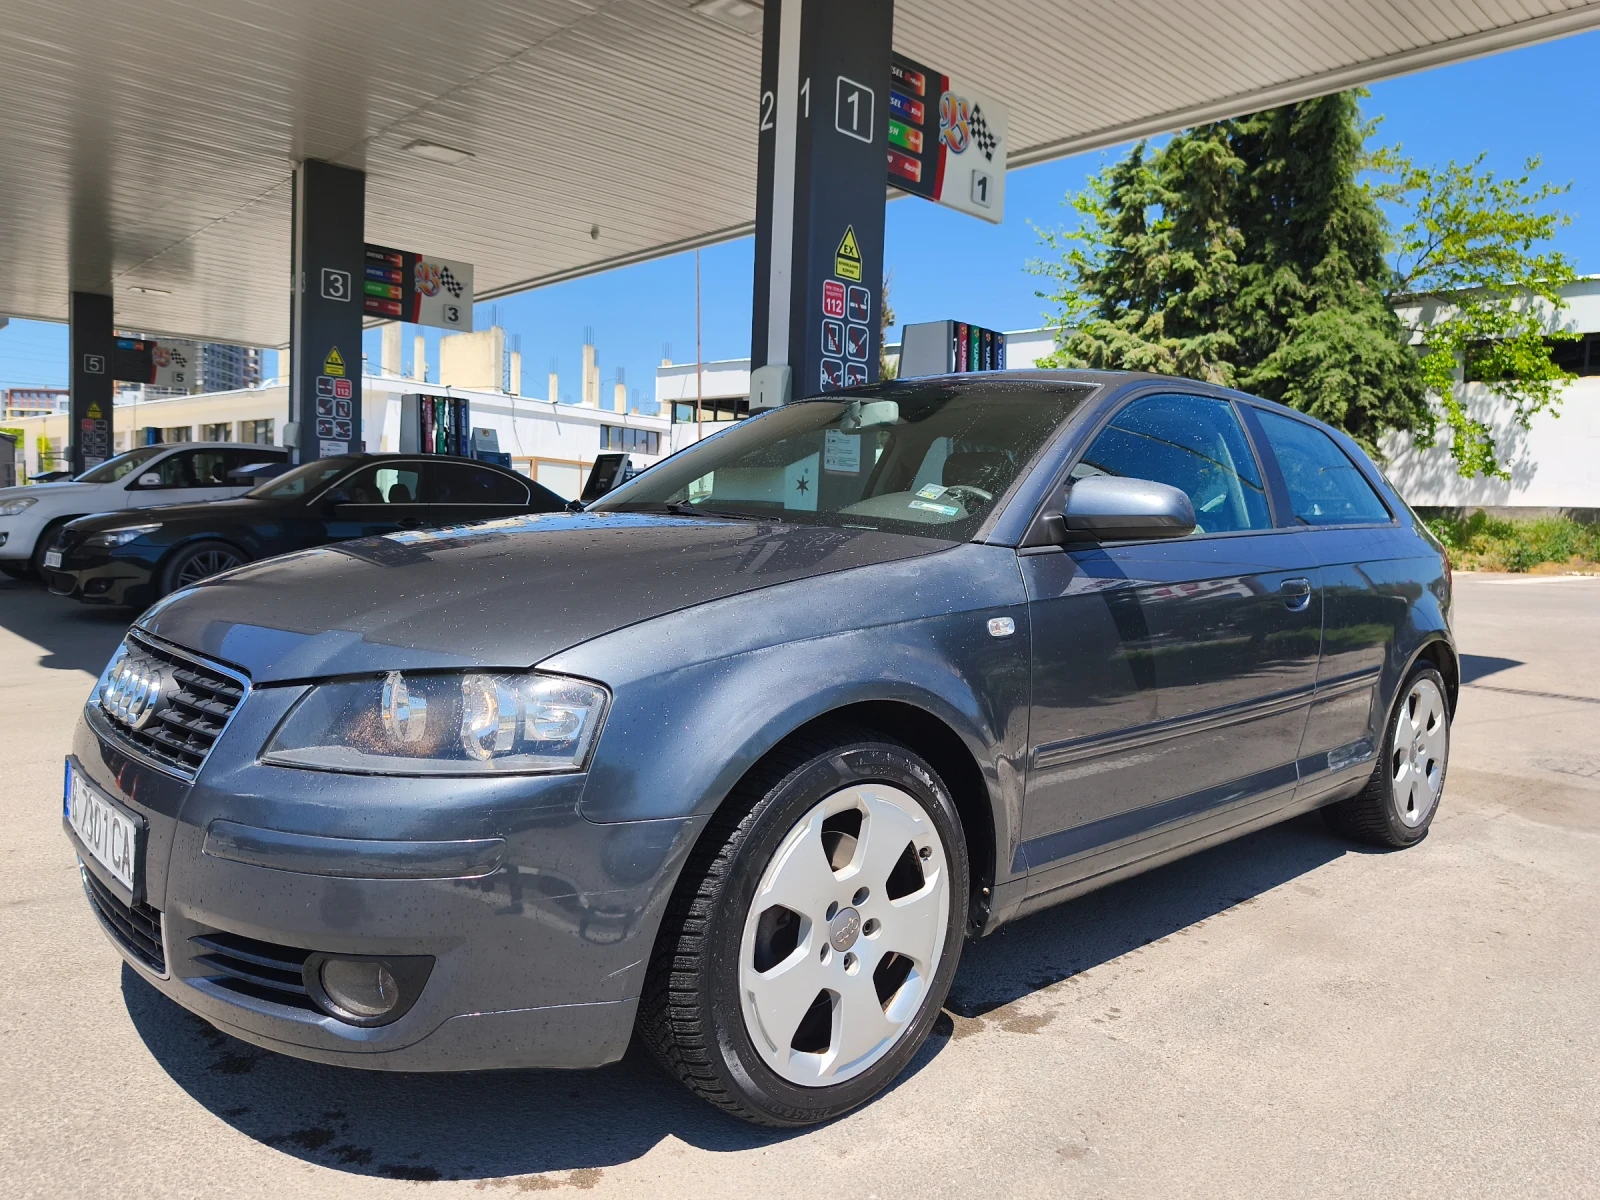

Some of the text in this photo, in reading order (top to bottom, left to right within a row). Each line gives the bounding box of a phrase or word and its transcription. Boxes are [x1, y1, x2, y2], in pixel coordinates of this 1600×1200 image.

[800, 77, 811, 118] 1
[760, 90, 775, 131] 2
[846, 91, 859, 131] 1
[977, 176, 987, 203] 1
[843, 244, 854, 256] EX
[329, 273, 344, 297] 3
[826, 298, 842, 313] 112
[447, 307, 459, 322] 3
[88, 358, 100, 371] 5
[176, 373, 184, 383] 5
[336, 388, 349, 396] 112
